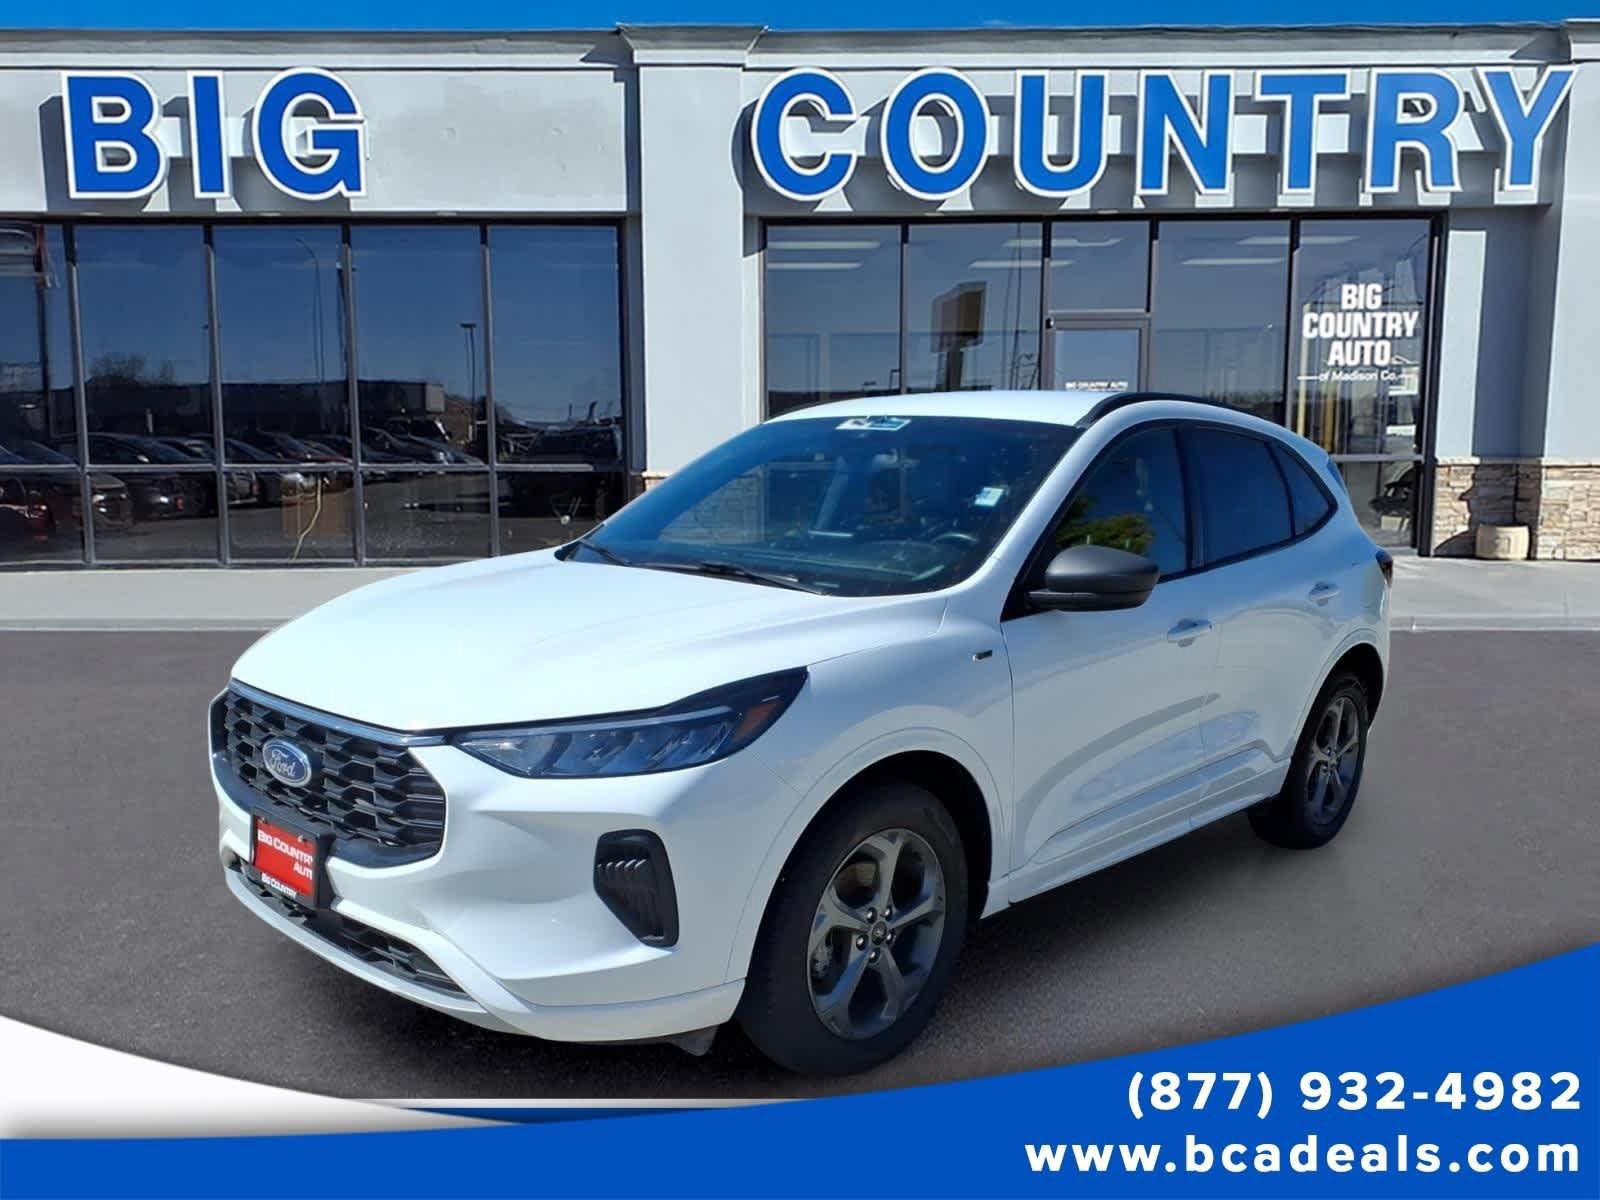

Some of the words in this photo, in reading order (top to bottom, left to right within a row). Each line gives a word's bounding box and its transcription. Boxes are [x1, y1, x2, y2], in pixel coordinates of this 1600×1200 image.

[61, 66, 367, 200] BIG
[750, 65, 1579, 205] COUNTRY
[1341, 283, 1382, 310] BIG
[1303, 311, 1419, 338] COUNTRY
[1327, 339, 1391, 366] AUTO
[1331, 370, 1378, 381] Madison
[270, 749, 296, 777] Ford
[293, 861, 313, 881] AUT
